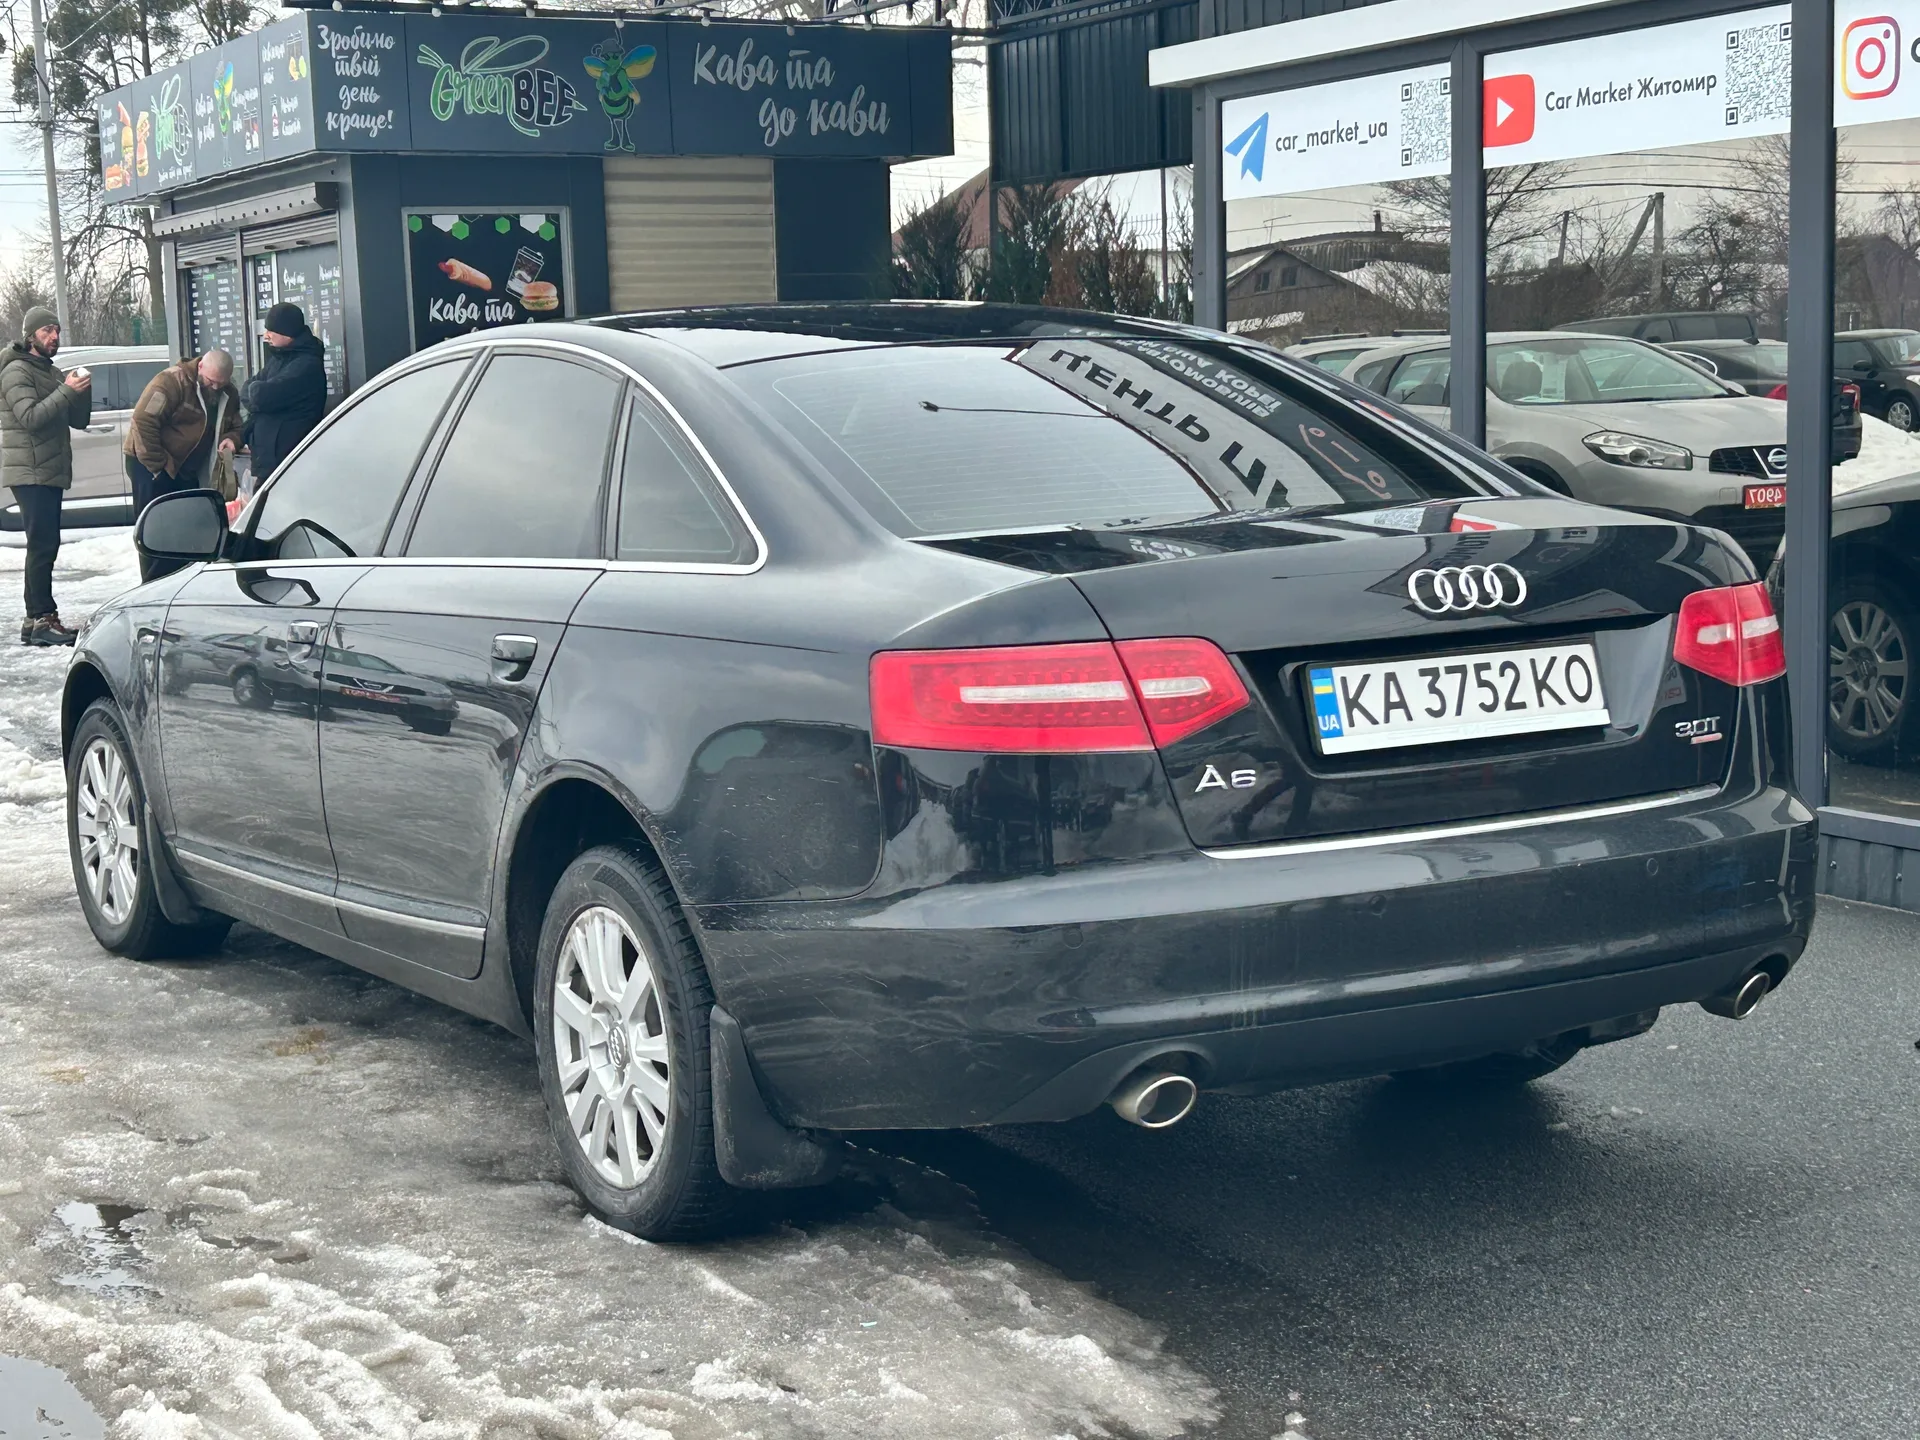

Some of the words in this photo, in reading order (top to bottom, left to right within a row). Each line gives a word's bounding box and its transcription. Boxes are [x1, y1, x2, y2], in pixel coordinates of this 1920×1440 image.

[317, 24, 395, 58] Зробимо
[335, 50, 381, 77] твій
[694, 38, 778, 91] Кава
[786, 50, 836, 90] та
[339, 85, 381, 110] день
[1545, 91, 1573, 111] Car
[1576, 81, 1633, 107] Market
[1637, 74, 1718, 99] Житомир
[325, 109, 393, 140] краще!
[759, 97, 798, 147] до
[806, 84, 891, 136] кави
[1275, 120, 1388, 154] car_market_ua
[429, 293, 481, 324] Кава
[485, 299, 515, 322] та
[1319, 715, 1340, 731] UA
[1194, 764, 1257, 792] A6
